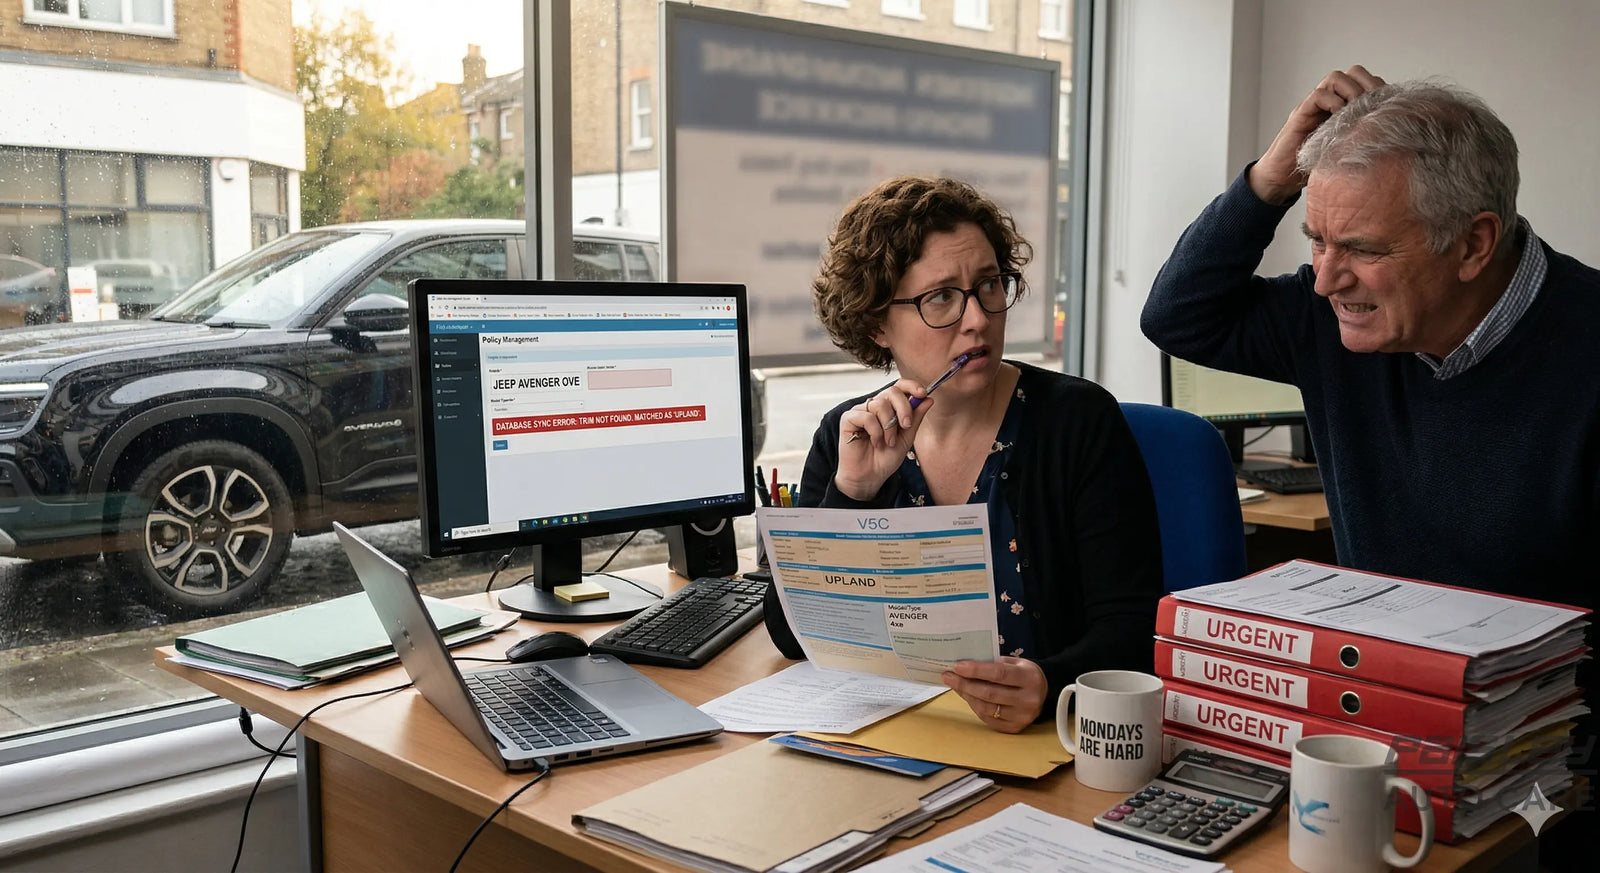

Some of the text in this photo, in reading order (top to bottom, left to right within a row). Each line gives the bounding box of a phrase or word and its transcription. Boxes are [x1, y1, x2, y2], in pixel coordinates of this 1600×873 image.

[482, 336, 539, 344] Policy Management
[493, 376, 580, 390] JEEP AVENGER OVE
[496, 420, 532, 431] DATABASE
[533, 420, 552, 428] SYNC
[553, 419, 577, 427] ERROR:
[595, 416, 609, 424] NOT
[610, 415, 634, 423] FOUND.
[634, 413, 663, 421] MATCHED
[857, 517, 890, 530] V5C
[825, 575, 876, 588] UPLAND
[889, 612, 928, 620] AVENGER
[1207, 618, 1299, 654] URGENT
[1204, 661, 1295, 699] URGENT
[1080, 717, 1143, 741] MONDAYS
[1197, 704, 1289, 744] URGENT
[1080, 736, 1144, 760] ARE HARD
